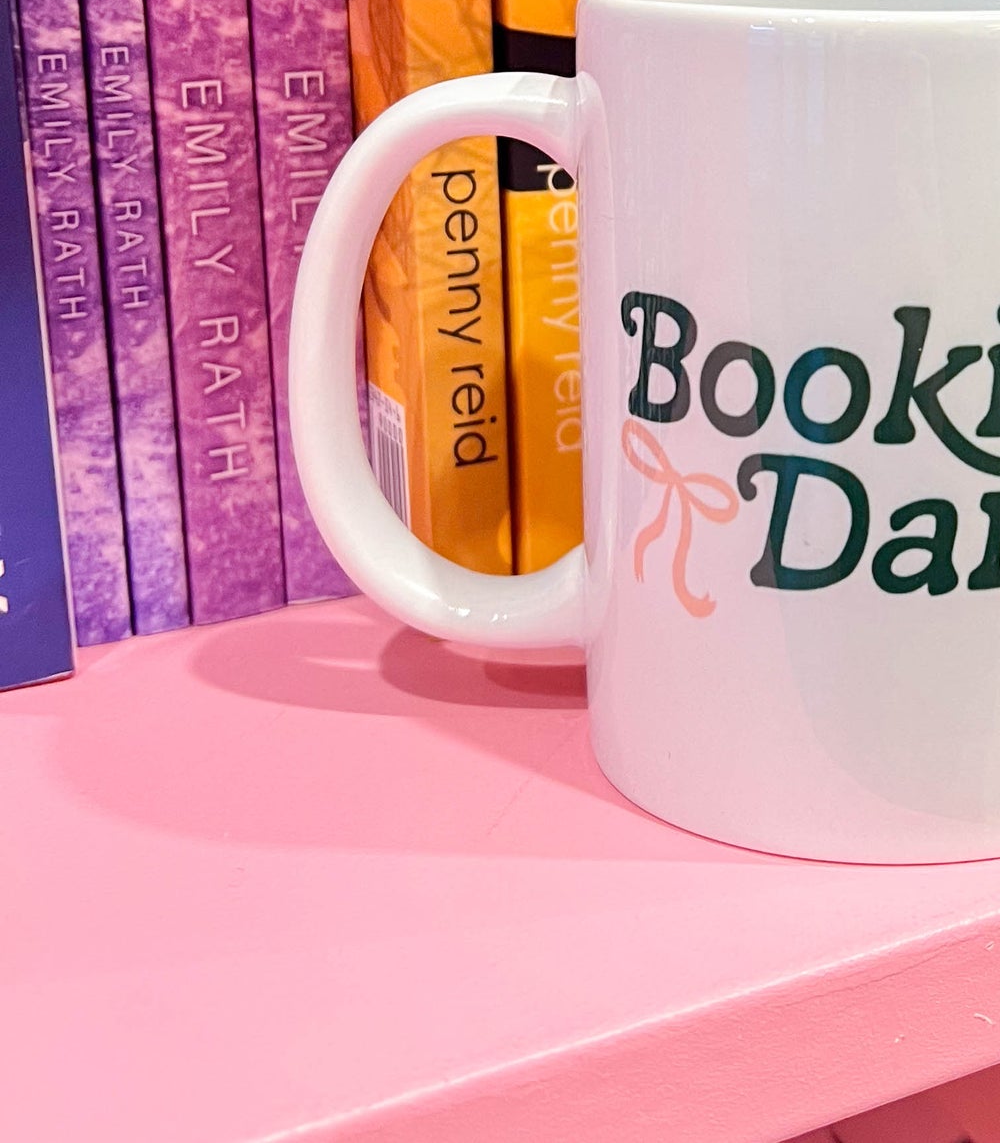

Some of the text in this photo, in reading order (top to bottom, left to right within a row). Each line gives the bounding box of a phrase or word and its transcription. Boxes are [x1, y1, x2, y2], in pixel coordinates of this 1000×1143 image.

[38, 53, 88, 321] EMILY RATH
[101, 46, 150, 310] EMILY RATH
[180, 79, 249, 483] EMILY RATH
[284, 70, 328, 254] EMIL
[537, 163, 579, 341] penny
[431, 169, 498, 468] penny reid
